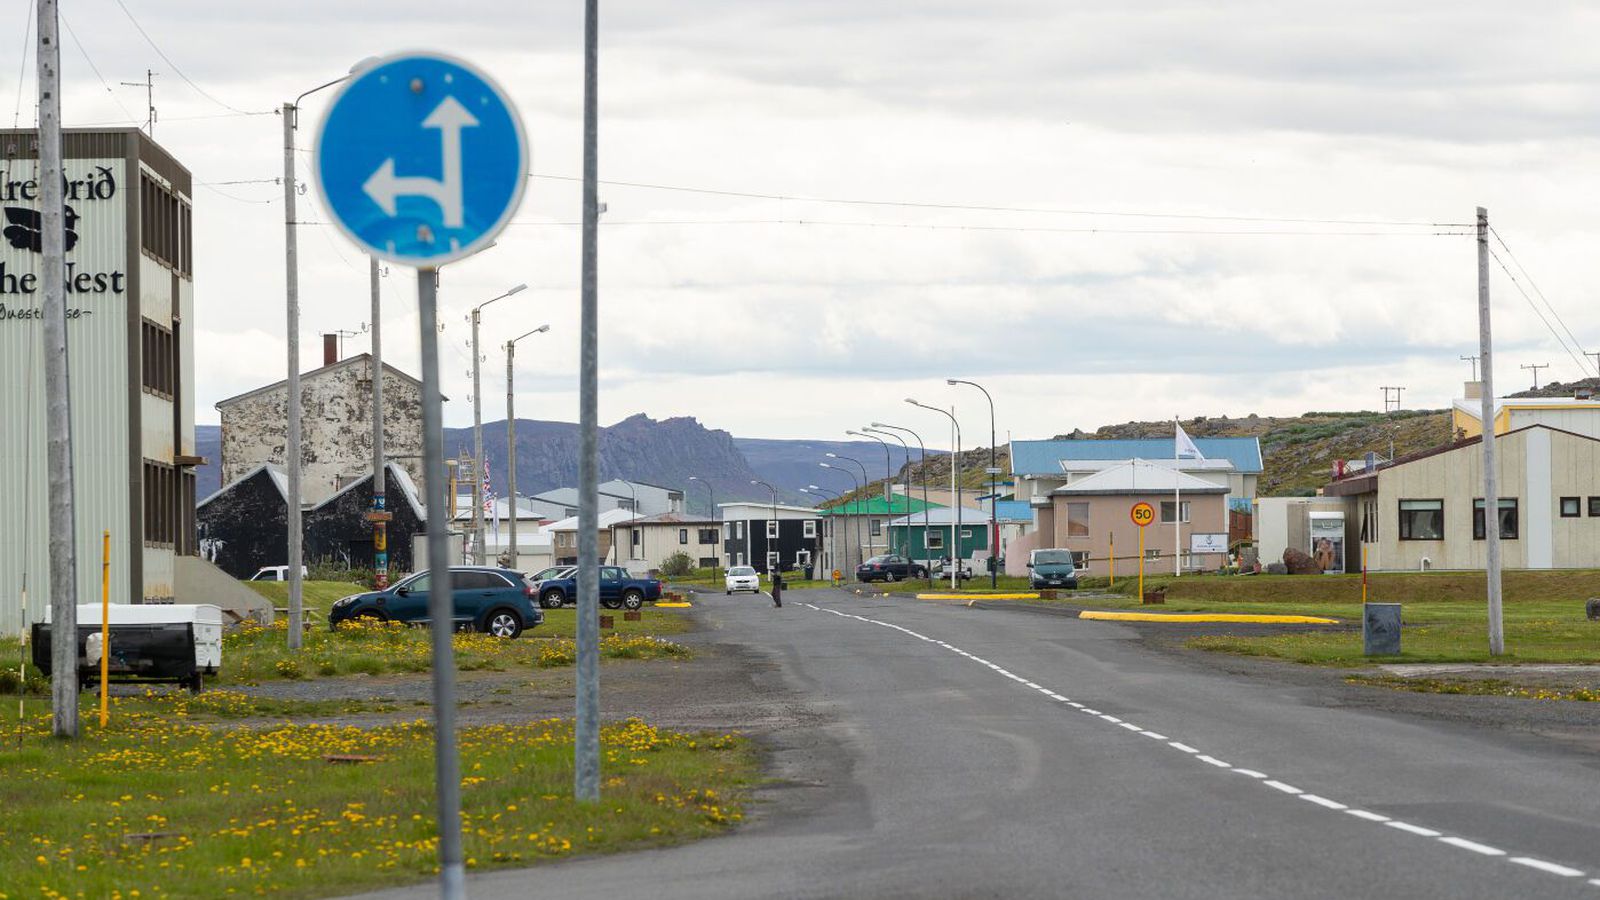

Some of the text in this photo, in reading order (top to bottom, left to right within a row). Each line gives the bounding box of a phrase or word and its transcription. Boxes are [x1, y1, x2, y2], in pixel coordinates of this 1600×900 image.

[0, 166, 115, 200] rerið
[0, 261, 37, 294] he
[1135, 509, 1151, 519] 50
